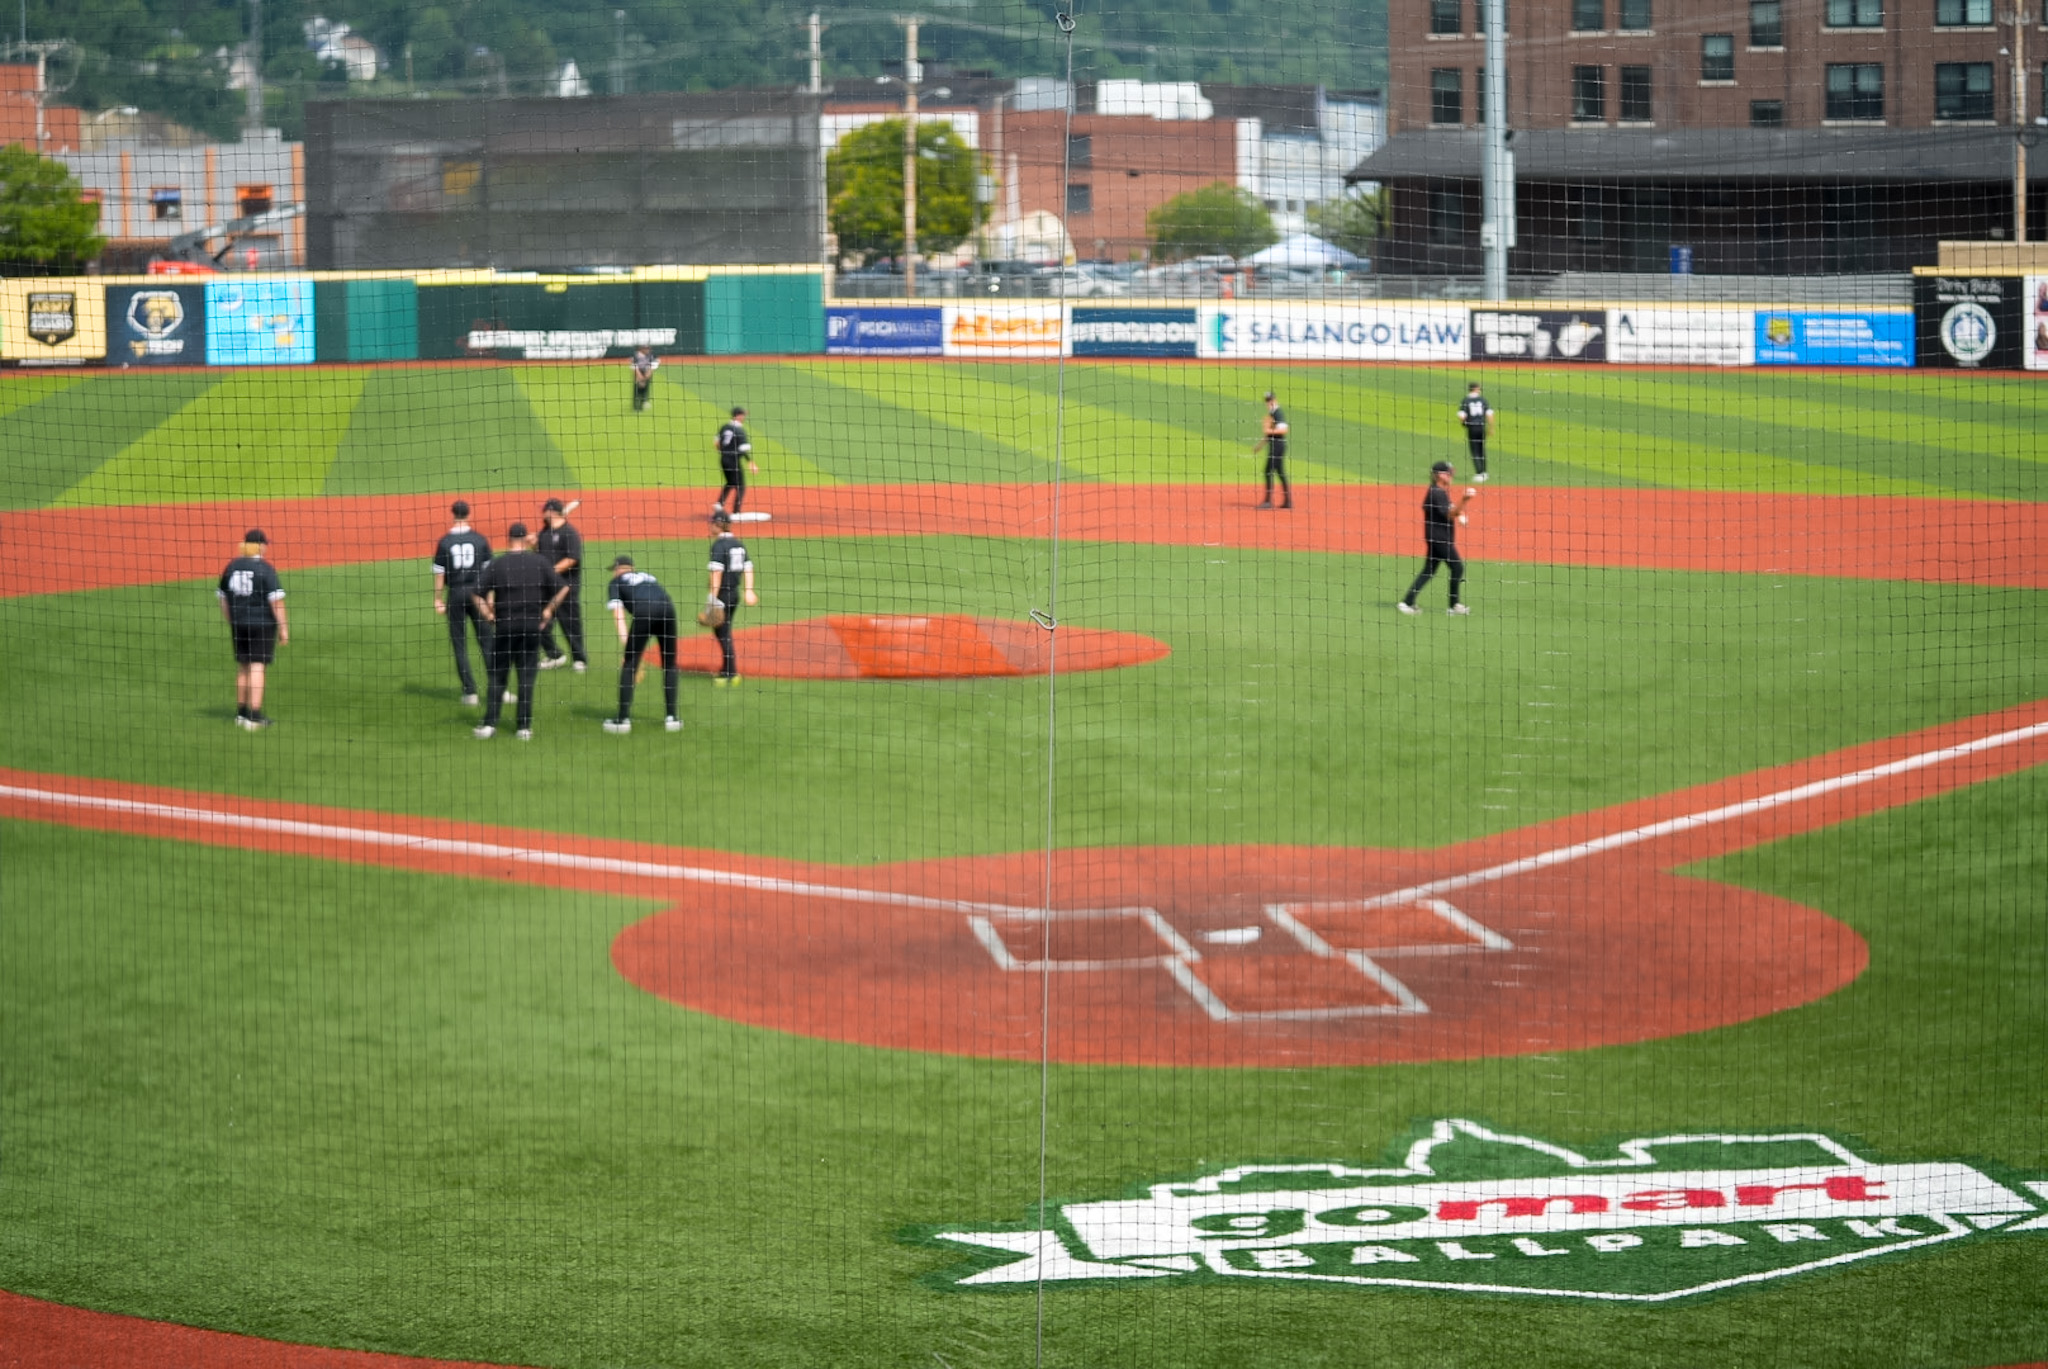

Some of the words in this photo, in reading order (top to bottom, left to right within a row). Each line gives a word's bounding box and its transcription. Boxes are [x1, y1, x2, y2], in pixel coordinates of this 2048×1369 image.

[1250, 322, 1392, 345] SALANGO
[1399, 323, 1464, 345] LAW
[1190, 1175, 1890, 1241] gomart
[1249, 1217, 1925, 1270] BALLPARK
